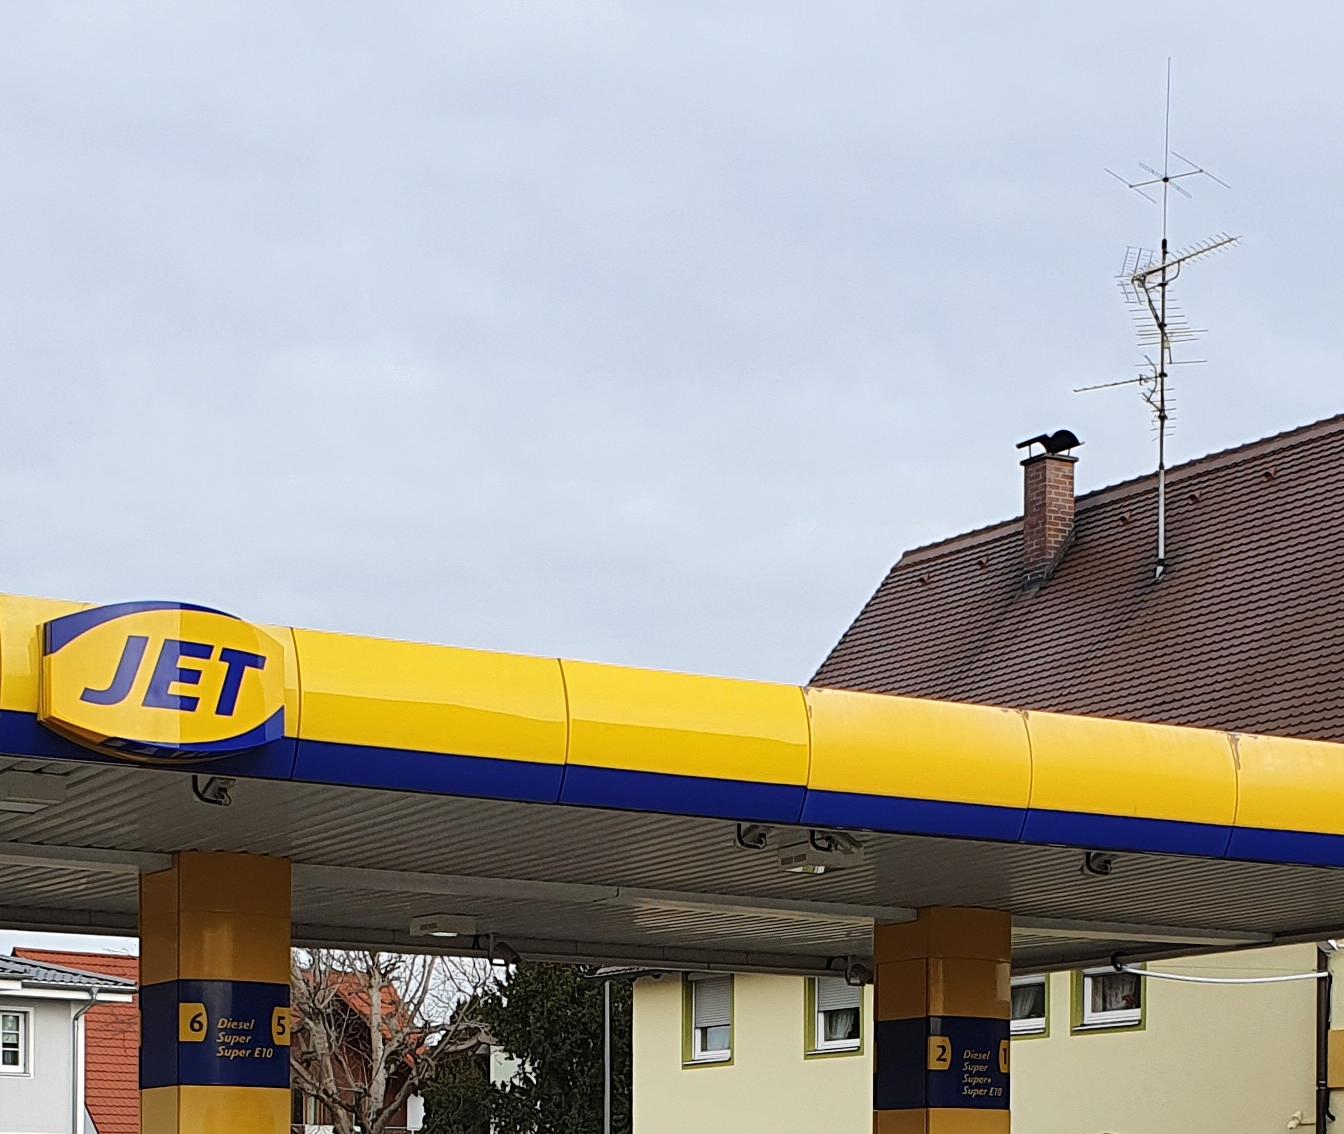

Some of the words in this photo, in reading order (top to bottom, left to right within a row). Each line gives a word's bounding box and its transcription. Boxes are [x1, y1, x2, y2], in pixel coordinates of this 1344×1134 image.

[80, 636, 267, 716] JET
[189, 1012, 203, 1032] 6
[217, 1018, 255, 1030] Diesel
[276, 1016, 286, 1035] 5
[216, 1032, 252, 1046] Super
[216, 1046, 251, 1060] Super
[254, 1047, 273, 1059] E10
[936, 1045, 947, 1062] 2
[963, 1050, 990, 1060] Diesel
[1002, 1048, 1007, 1064] 1
[962, 1062, 988, 1074] Super
[962, 1086, 987, 1098] Super
